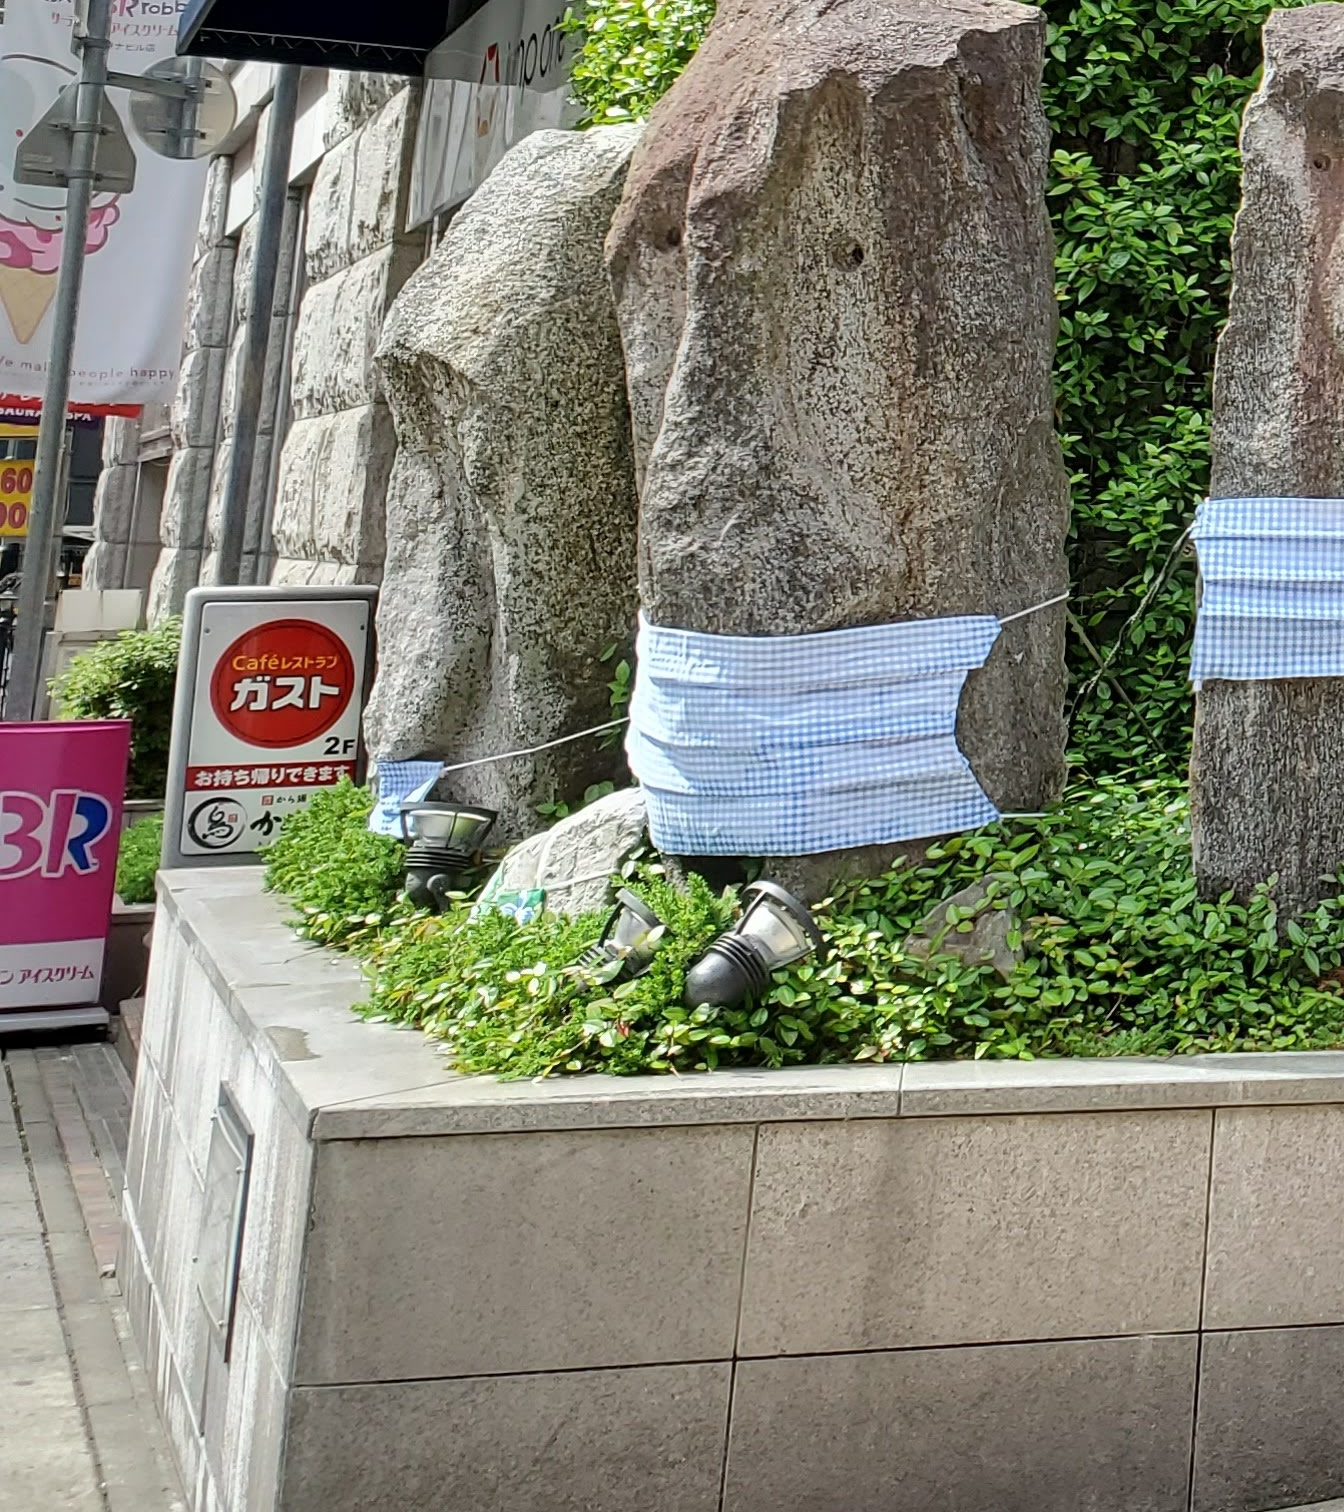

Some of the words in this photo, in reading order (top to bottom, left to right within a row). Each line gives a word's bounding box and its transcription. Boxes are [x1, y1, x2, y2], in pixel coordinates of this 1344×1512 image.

[229, 675, 341, 711] ガスト
[323, 737, 356, 755] 2F
[18, 965, 95, 985] アイスクリーム
